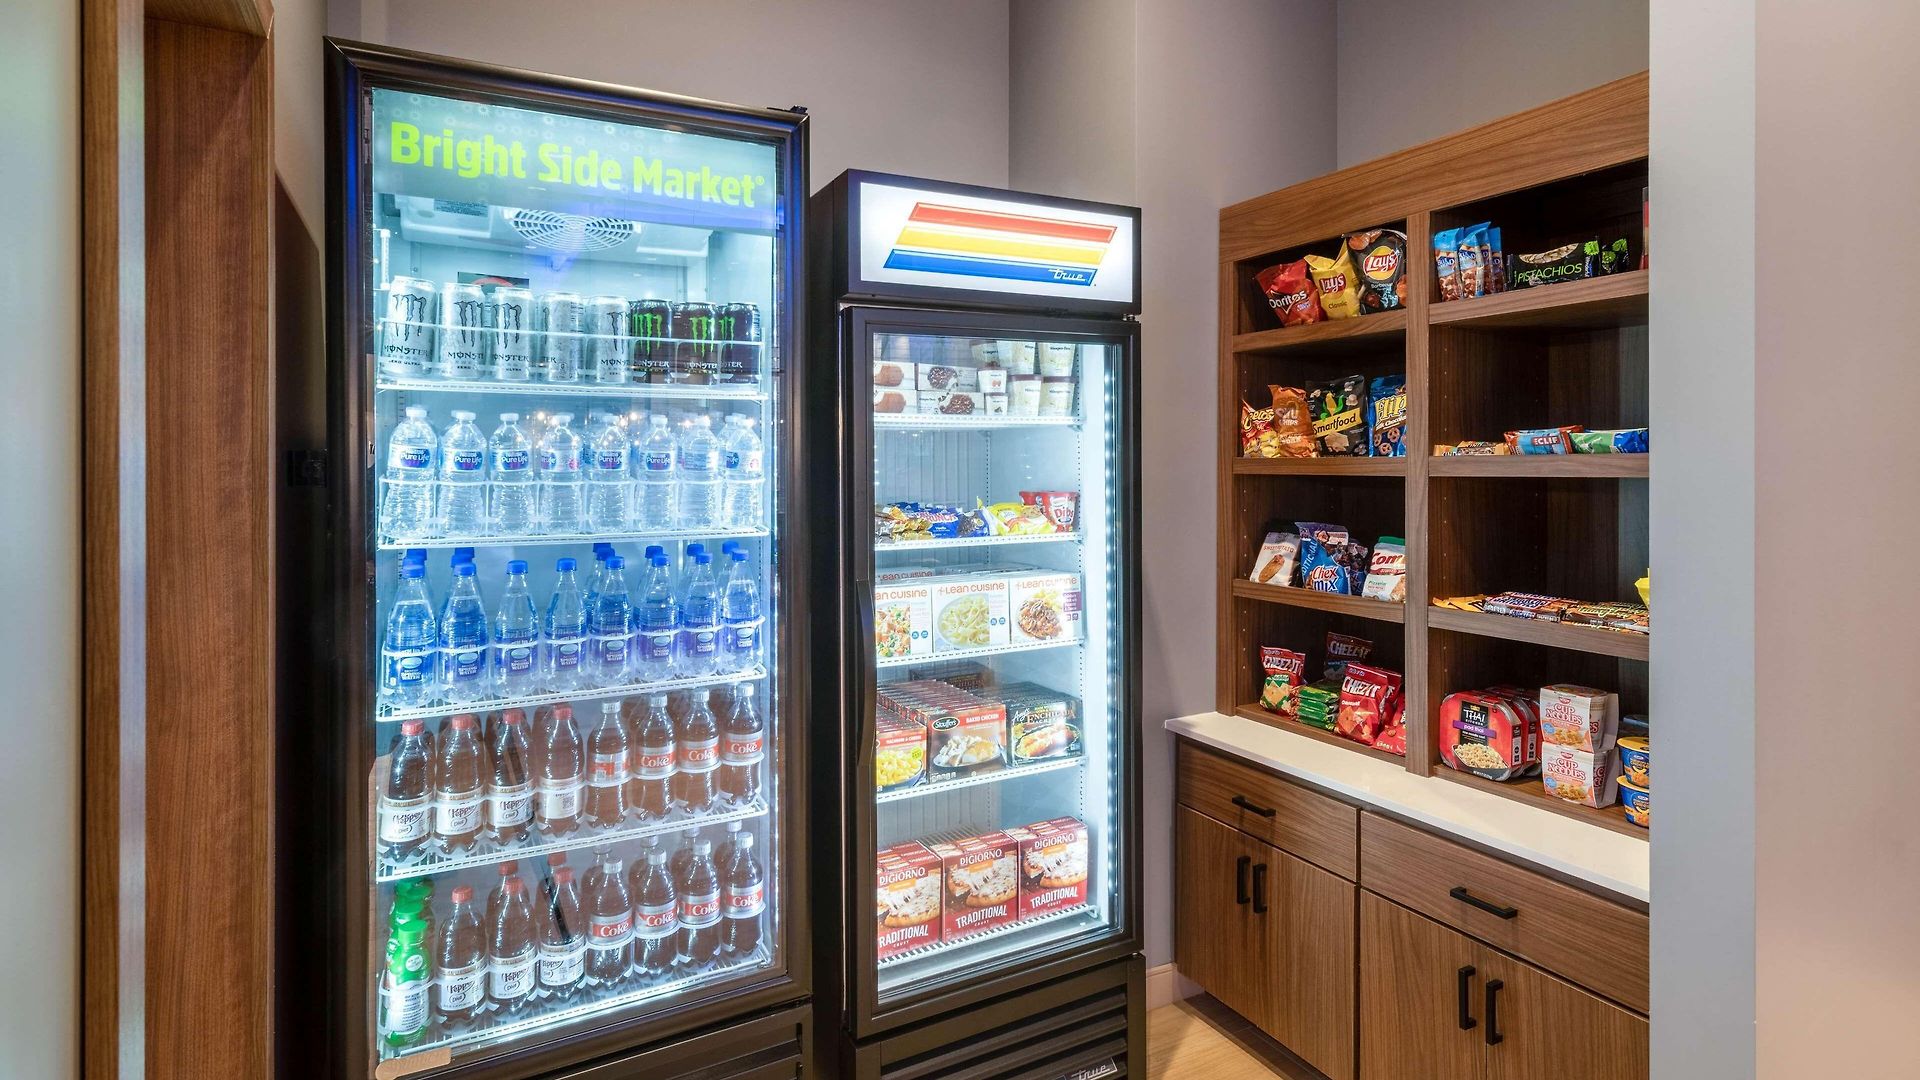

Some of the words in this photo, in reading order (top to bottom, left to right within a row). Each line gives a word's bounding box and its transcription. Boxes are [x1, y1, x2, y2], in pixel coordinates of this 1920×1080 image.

[391, 121, 527, 179] Bright
[538, 143, 622, 189] Side
[1049, 268, 1087, 282] true
[1518, 263, 1583, 284] PISTACHIOS
[1268, 290, 1307, 309] Doritos
[1313, 412, 1357, 435] Smartfood
[401, 452, 418, 460] Pure
[455, 455, 471, 463] Pure
[502, 455, 517, 463] Pure
[1312, 566, 1339, 580] Chex
[1463, 708, 1486, 722] THAI
[1554, 703, 1575, 714] CUP
[1546, 708, 1583, 725] NOODLES
[688, 748, 716, 762] Coke
[731, 742, 758, 754] Coke
[640, 755, 670, 768] Coke
[1556, 758, 1578, 769] CUP
[1547, 763, 1586, 780] NOODLES
[732, 895, 759, 908] Coke
[1030, 887, 1078, 909] TRADITIONAL
[692, 903, 719, 916] Coke
[955, 904, 1008, 929] TRADITIONAL
[646, 912, 675, 927] Coke
[600, 922, 629, 938] Coke
[878, 924, 929, 948] RADITIONAL
